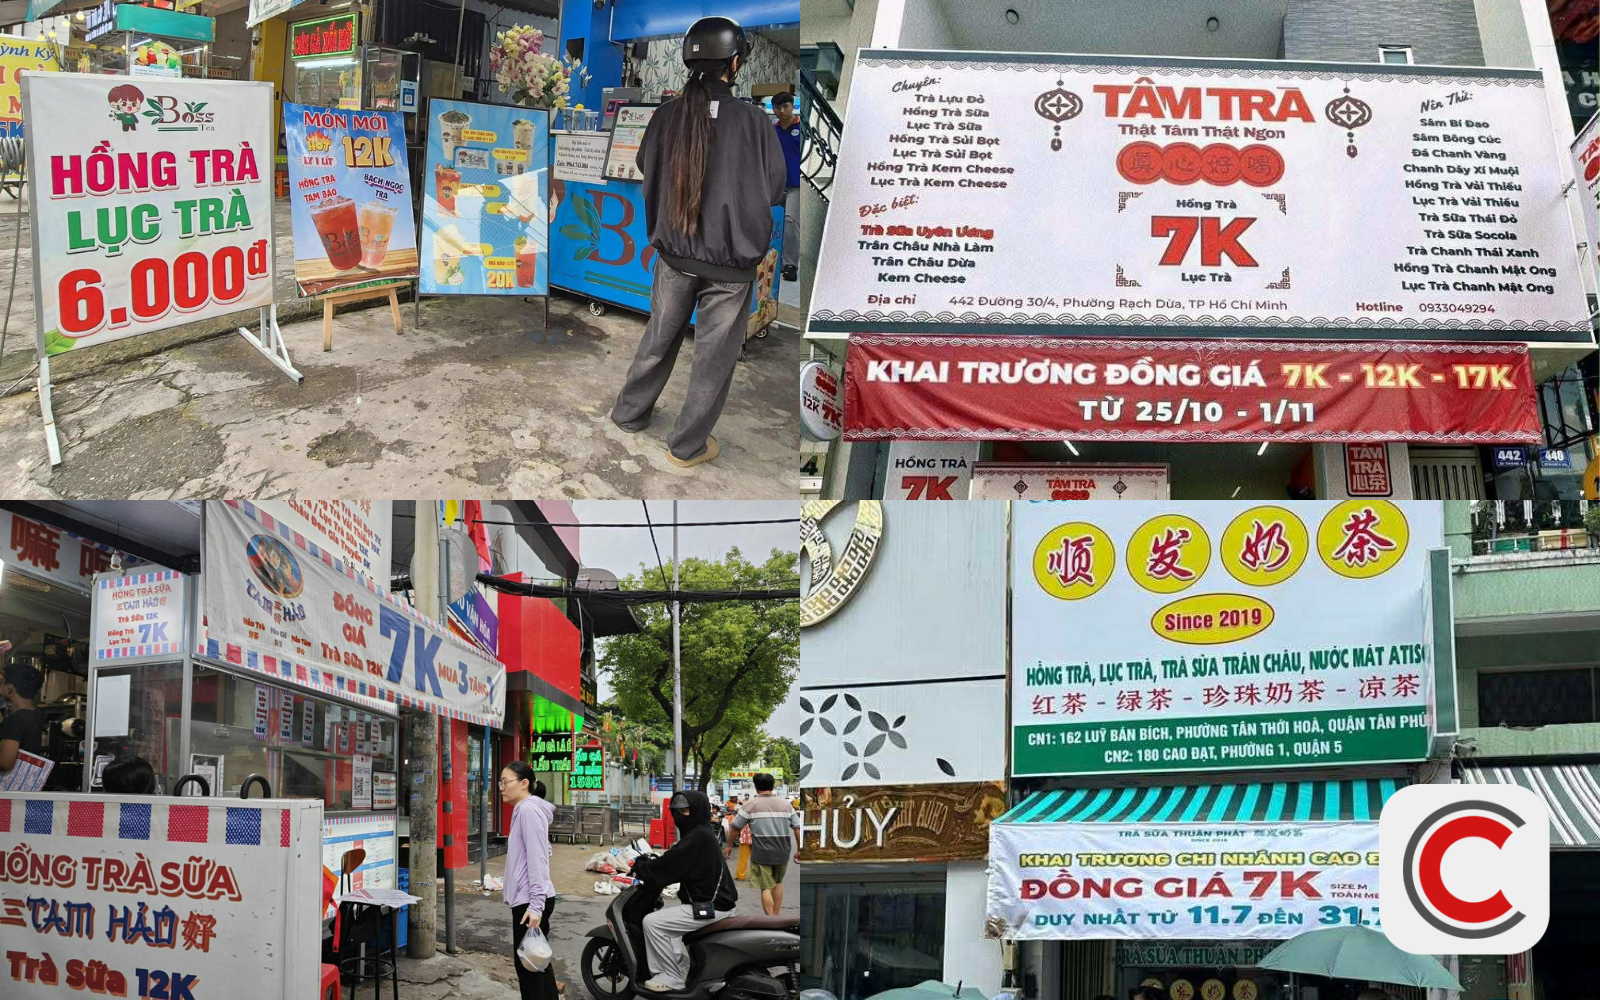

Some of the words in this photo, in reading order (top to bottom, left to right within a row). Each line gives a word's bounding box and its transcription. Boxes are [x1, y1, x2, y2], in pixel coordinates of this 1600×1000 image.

[156, 95, 215, 124] Boss
[1093, 77, 1201, 119] TÂM
[199, 124, 215, 132] Tea
[303, 110, 347, 129] MÓN
[353, 113, 388, 131] MỚI
[1118, 123, 1156, 137] Thật
[1162, 124, 1198, 137] Tâm
[1202, 125, 1239, 139] Thật
[1244, 127, 1285, 141] Ngon
[308, 140, 331, 152] HOT
[342, 136, 395, 168] 12K
[50, 140, 179, 199] HỒNG
[189, 141, 260, 186] TRÀ
[303, 156, 314, 165] LY
[315, 157, 319, 165] 1
[321, 155, 333, 165] LÍT
[867, 161, 903, 174] Hồng
[907, 163, 928, 172] Trà
[932, 164, 962, 174] Kem
[966, 164, 1015, 174] Cheese
[298, 177, 319, 189] HỒNG
[364, 173, 383, 187] BẠCH
[304, 192, 320, 203] TAM
[1176, 198, 1211, 212] Hồng
[1215, 199, 1237, 210] Trà
[67, 203, 161, 256] LỤC
[174, 189, 252, 237] TRÀ
[1150, 215, 1259, 268] 7K
[1406, 246, 1427, 256] Trà
[1431, 247, 1472, 257] Chanh
[1475, 248, 1503, 257] Thái
[1506, 248, 1539, 258] Xanh
[486, 270, 515, 288] 20K
[878, 272, 910, 283] Kem
[914, 273, 967, 284] Cheese
[1181, 272, 1205, 284] Lục
[1209, 273, 1231, 283] Trà
[1394, 262, 1429, 275] Hồng
[1432, 264, 1454, 273] Trà
[1457, 264, 1499, 274] Chanh
[1502, 265, 1526, 276] Mật
[1529, 266, 1556, 277] Ong
[58, 239, 267, 336] 6.000đ
[1401, 281, 1426, 292] Lục
[1428, 281, 1450, 291] Trà
[1453, 282, 1495, 292] Chanh
[1498, 282, 1523, 293] Mật
[1526, 283, 1554, 294] Ong
[1356, 302, 1403, 312] Hotline
[1419, 303, 1495, 314] 0933049294
[866, 360, 951, 384] KHAI
[958, 358, 1097, 385] TRƯƠNG
[1104, 356, 1201, 386] ĐỒNG
[1209, 360, 1267, 387] GIÁ
[1280, 362, 1331, 389] 7K
[1361, 362, 1424, 389] 12K
[1453, 363, 1516, 390] 17K
[1079, 396, 1125, 421] TỪ
[1136, 400, 1223, 425] 25/10
[1260, 399, 1315, 425] 1/11
[895, 455, 936, 469] HỒNG
[940, 457, 967, 468] TRÀ
[1498, 450, 1521, 461] 442
[901, 475, 958, 500] 7K
[146, 612, 158, 620] 12K
[333, 591, 373, 627] ĐỒNG
[1164, 611, 1213, 632] Since
[1219, 608, 1262, 629] 2019
[139, 621, 169, 644] 7K
[343, 622, 367, 648] GIÁ
[321, 642, 341, 664] Trà
[344, 651, 364, 672] Sữa
[366, 660, 384, 678] 12K
[379, 602, 443, 699] 7K
[438, 662, 458, 685] MUA
[458, 661, 468, 695] 3
[469, 676, 489, 697] TẶNG
[1032, 692, 1086, 715] 红茶
[1116, 688, 1172, 711] 绿茶
[1203, 679, 1325, 708] 珍珠奶茶
[1360, 674, 1420, 699] 凉茶
[1028, 732, 1056, 746] CN1:
[1060, 732, 1081, 744] 162
[1110, 726, 1136, 742] BÁN
[1140, 725, 1172, 741] BÍCH,
[1176, 722, 1228, 739] PHƯỜNG
[1232, 720, 1257, 737] TÂN
[1261, 719, 1289, 735] THỚI
[1293, 717, 1324, 734] HOÀ,
[1328, 715, 1365, 734] QUẬN
[1369, 713, 1396, 729] TÂN
[1400, 711, 1428, 728] PHÚ
[1105, 750, 1133, 763] CN2:
[1137, 749, 1158, 761] 180
[1163, 748, 1187, 760] CAO
[1191, 746, 1217, 762] ĐẠT,
[1221, 741, 1274, 759] PHƯỜNG
[1278, 743, 1289, 757] 1,
[1293, 739, 1330, 758] QUẬN
[1334, 741, 1343, 753] 5
[570, 776, 602, 788] 159K
[800, 794, 898, 849] HỦY
[1020, 853, 1072, 868] KHAI
[1077, 852, 1171, 868] TRƯƠNG
[1176, 852, 1216, 867] CHI
[1221, 849, 1305, 866] NHÁNH
[1309, 851, 1361, 866] CAO
[82, 853, 158, 895] TRÀ
[159, 856, 242, 901] SỮA
[1019, 868, 1143, 900] ĐỒNG
[1154, 871, 1233, 899] GIÁ
[1242, 870, 1323, 900] 7K
[26, 896, 95, 940] TAM
[106, 902, 179, 949] HẢO
[180, 911, 217, 952] 好
[1035, 914, 1075, 926] DUY
[1083, 907, 1140, 925] NHẤT
[1148, 909, 1178, 925] TỪ
[1187, 905, 1253, 924] 11.7
[1258, 907, 1303, 925] ĐẾN
[6, 950, 59, 986] Trà
[65, 959, 128, 998] Sữa
[136, 968, 200, 1000] 12K
